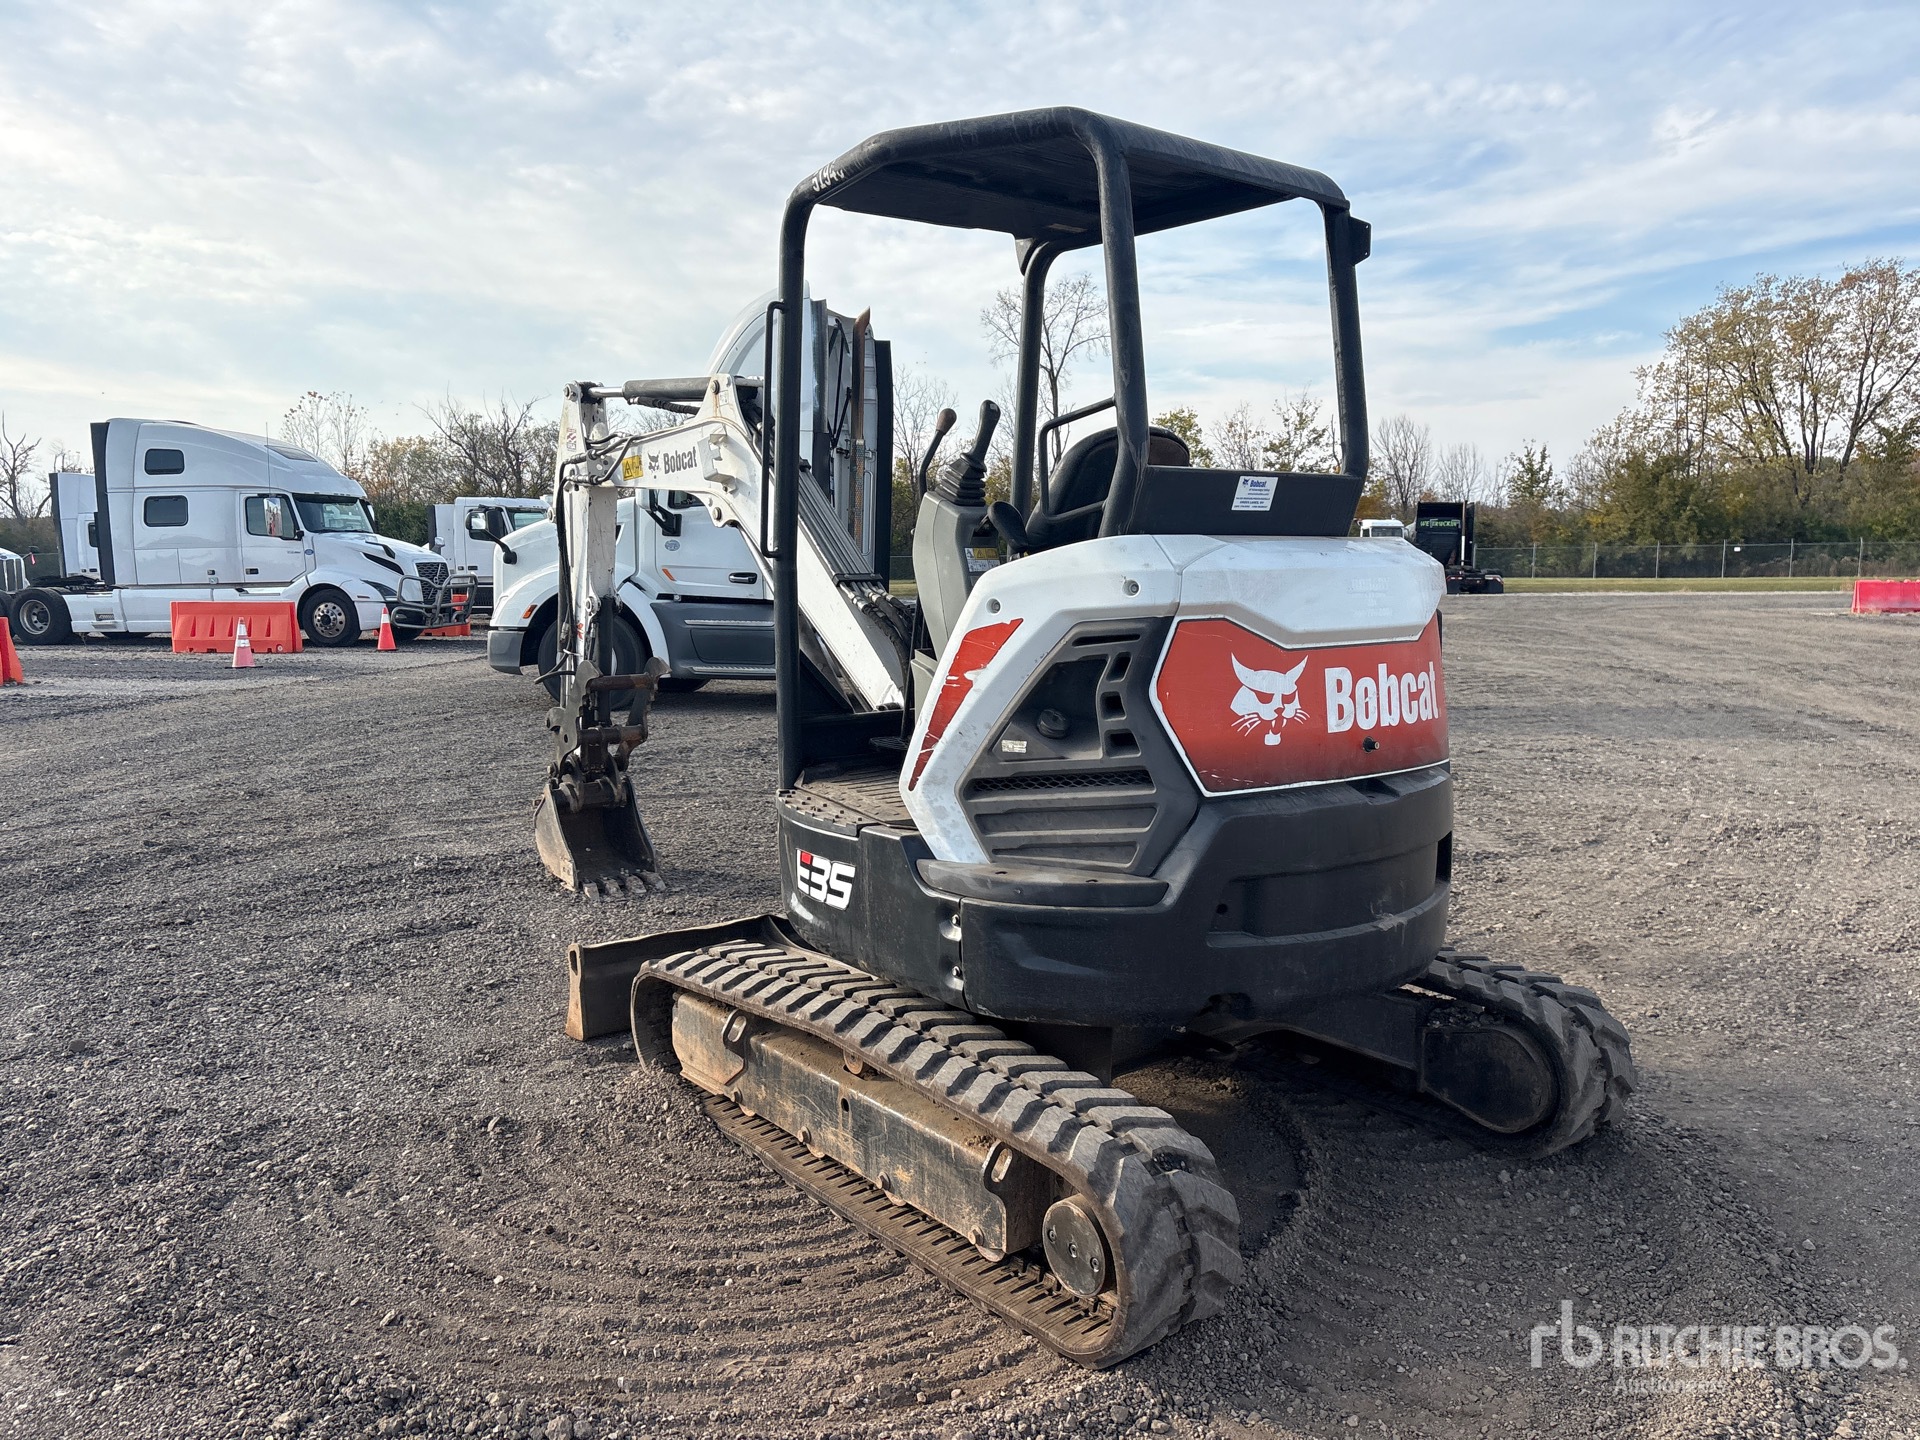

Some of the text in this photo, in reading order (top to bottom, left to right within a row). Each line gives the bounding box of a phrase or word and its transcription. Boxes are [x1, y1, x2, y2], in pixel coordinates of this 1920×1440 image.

[663, 446, 697, 474] Bobcat
[1324, 661, 1438, 733] Bobcat
[796, 849, 856, 910] E35
